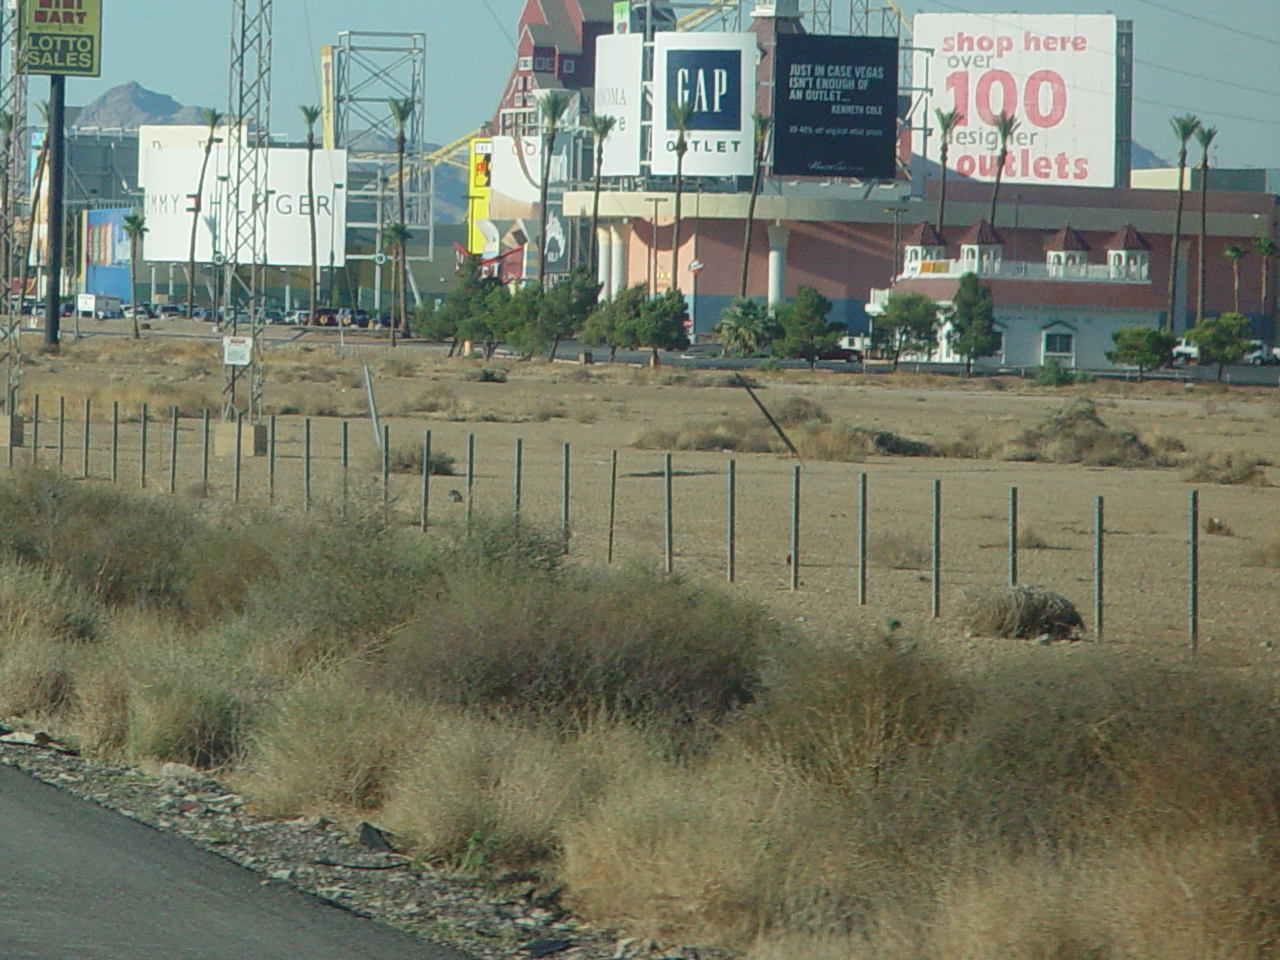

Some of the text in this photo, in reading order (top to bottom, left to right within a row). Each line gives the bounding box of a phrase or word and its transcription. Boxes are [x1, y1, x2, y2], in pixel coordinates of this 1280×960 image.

[34, 9, 87, 25] MART
[28, 35, 92, 52] LOTTO
[942, 31, 1088, 58] shop here
[27, 51, 92, 68] SALES
[946, 54, 995, 69] over
[789, 63, 884, 79] JUST IN CASE VEGAS
[677, 68, 727, 113] GAP
[816, 78, 856, 90] ENOUGH
[789, 89, 803, 100] AN
[945, 69, 1067, 129] 100
[666, 140, 741, 153] OTLET
[956, 148, 1089, 181] outlets
[145, 193, 180, 214] OMMY
